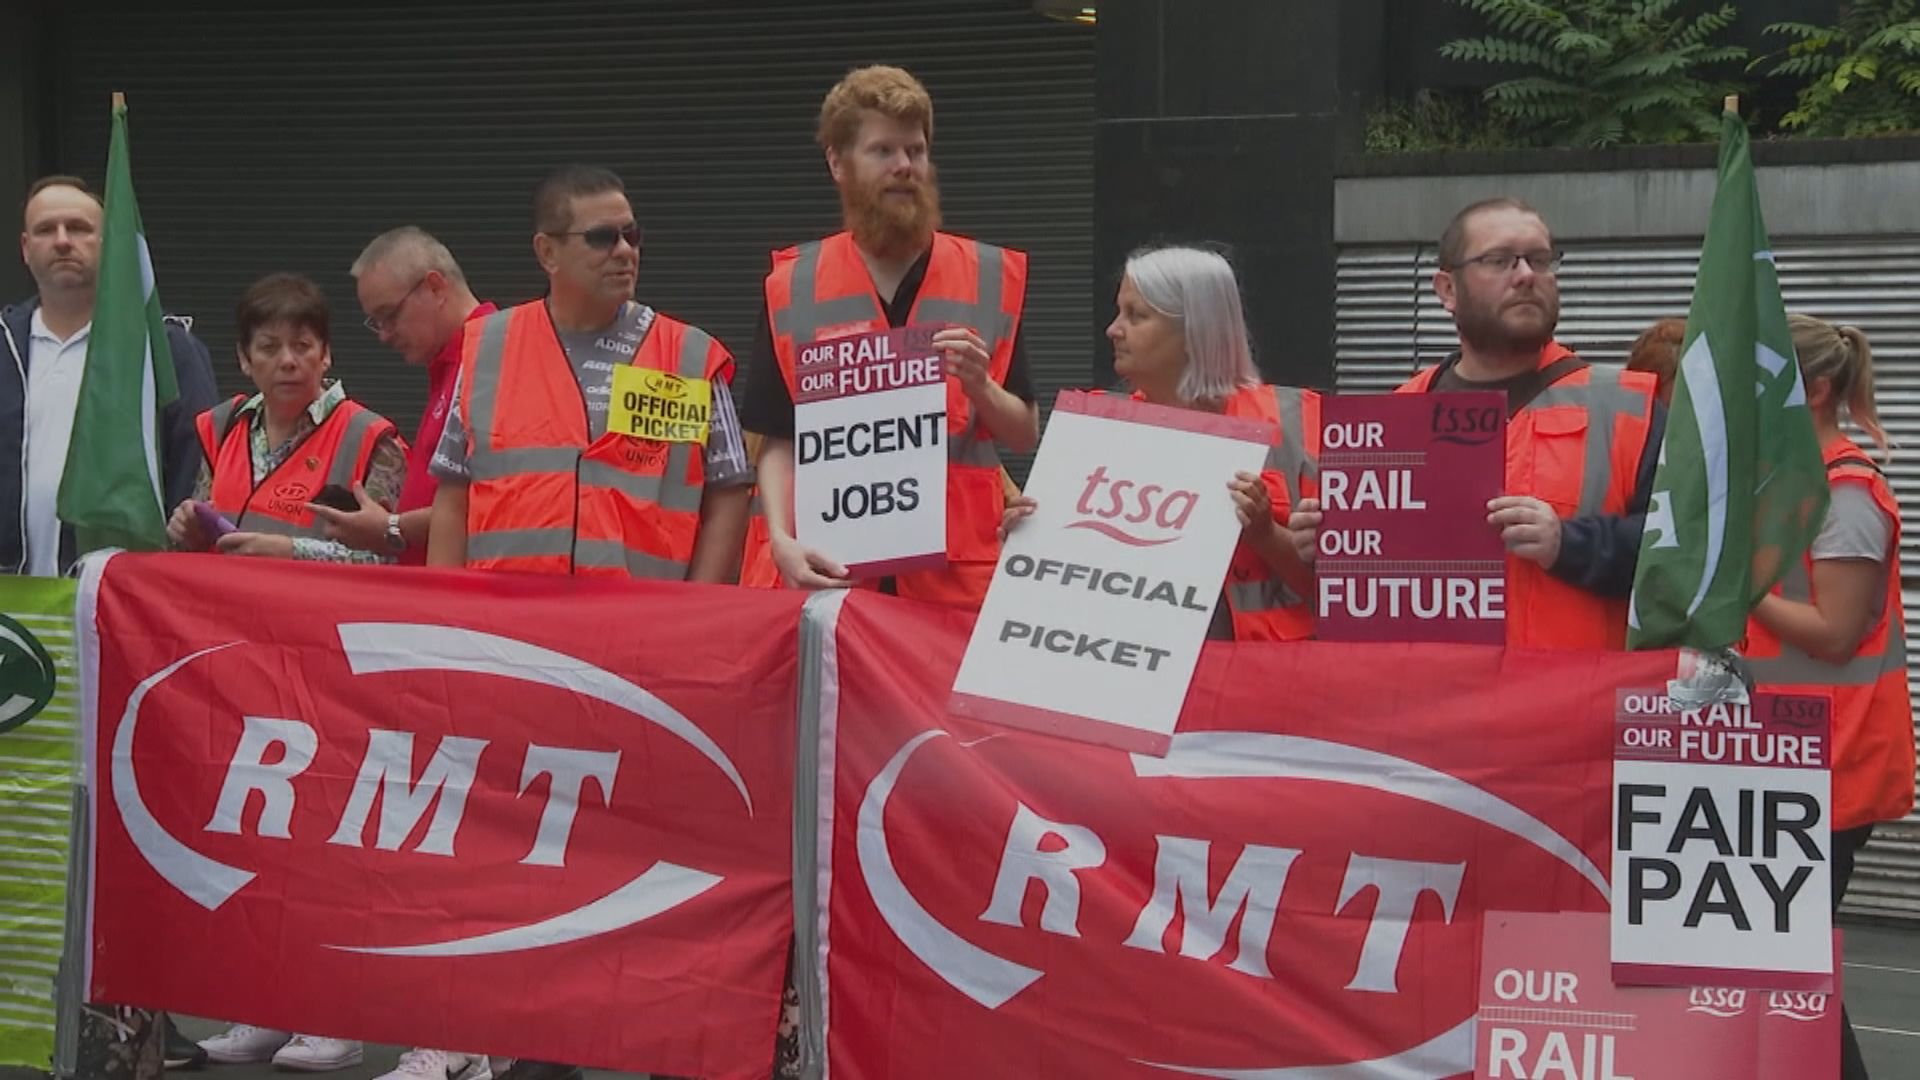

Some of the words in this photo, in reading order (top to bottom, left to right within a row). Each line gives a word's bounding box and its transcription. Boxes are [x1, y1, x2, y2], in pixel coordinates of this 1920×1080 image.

[801, 345, 834, 366] OUR
[839, 335, 896, 367] RAIL
[801, 372, 835, 392] OUR
[839, 356, 941, 394] FUTURE
[631, 414, 704, 439] PICKET
[1323, 422, 1384, 448] OUR
[1431, 402, 1499, 433] tssa
[799, 412, 946, 465] DECENT
[821, 477, 920, 523] JOBS
[1076, 466, 1200, 530] tssa
[1321, 470, 1426, 510] RAIL
[1319, 529, 1381, 555] OUR
[1004, 554, 1208, 611] OFFICIAL
[1319, 578, 1506, 619] FUTURE
[999, 620, 1171, 672] PICKET
[1624, 695, 1672, 715] OUR
[1680, 702, 1763, 729] RAIL
[1623, 727, 1672, 748] OUR
[1680, 731, 1822, 765] FUTURE
[203, 715, 622, 868] RMT
[1616, 783, 1826, 861] FAIR
[978, 801, 1466, 993] RMT
[1627, 856, 1814, 933] PAY
[1494, 968, 1578, 1003] OUR
[1488, 1028, 1635, 1080] RAIL
